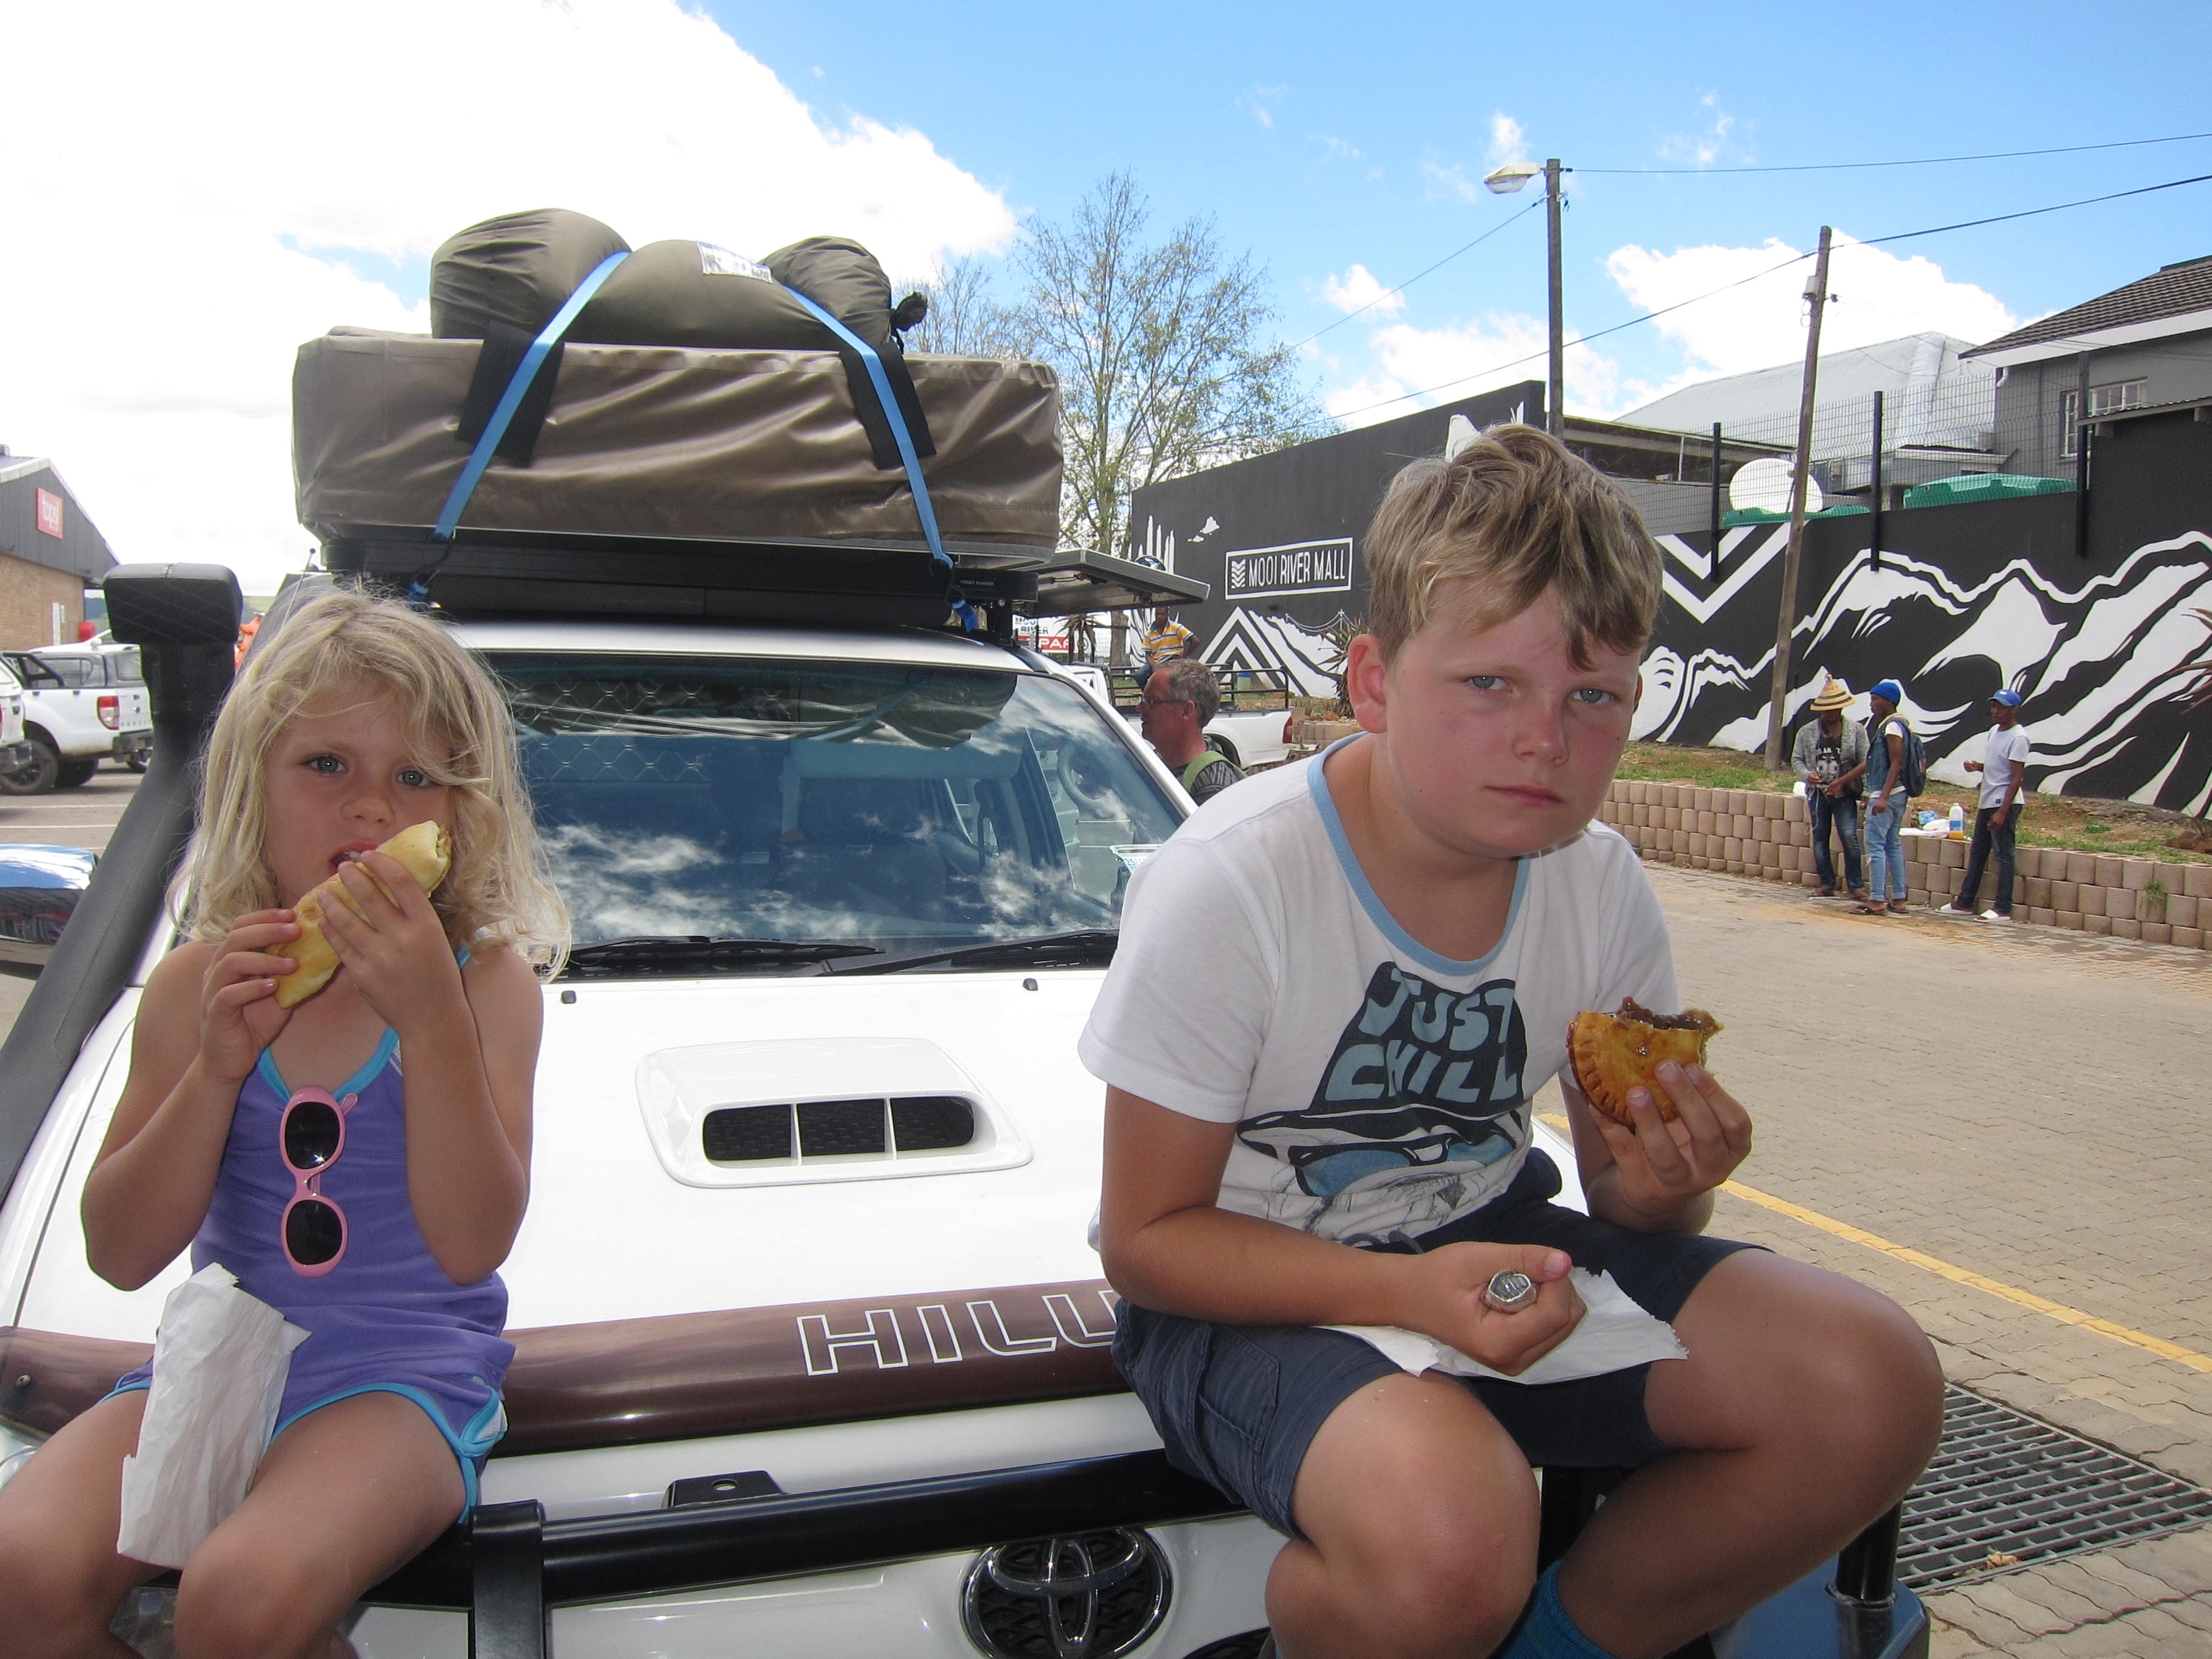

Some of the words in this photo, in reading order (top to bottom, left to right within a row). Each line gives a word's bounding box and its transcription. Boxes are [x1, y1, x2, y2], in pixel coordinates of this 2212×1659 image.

[1249, 555, 1278, 587] MOOI
[1280, 551, 1311, 585] RIVER
[1314, 549, 1346, 581] MALL
[1358, 968, 1515, 1051] JUST
[1324, 1039, 1517, 1103] CHILL
[796, 1289, 1120, 1376] HILU
